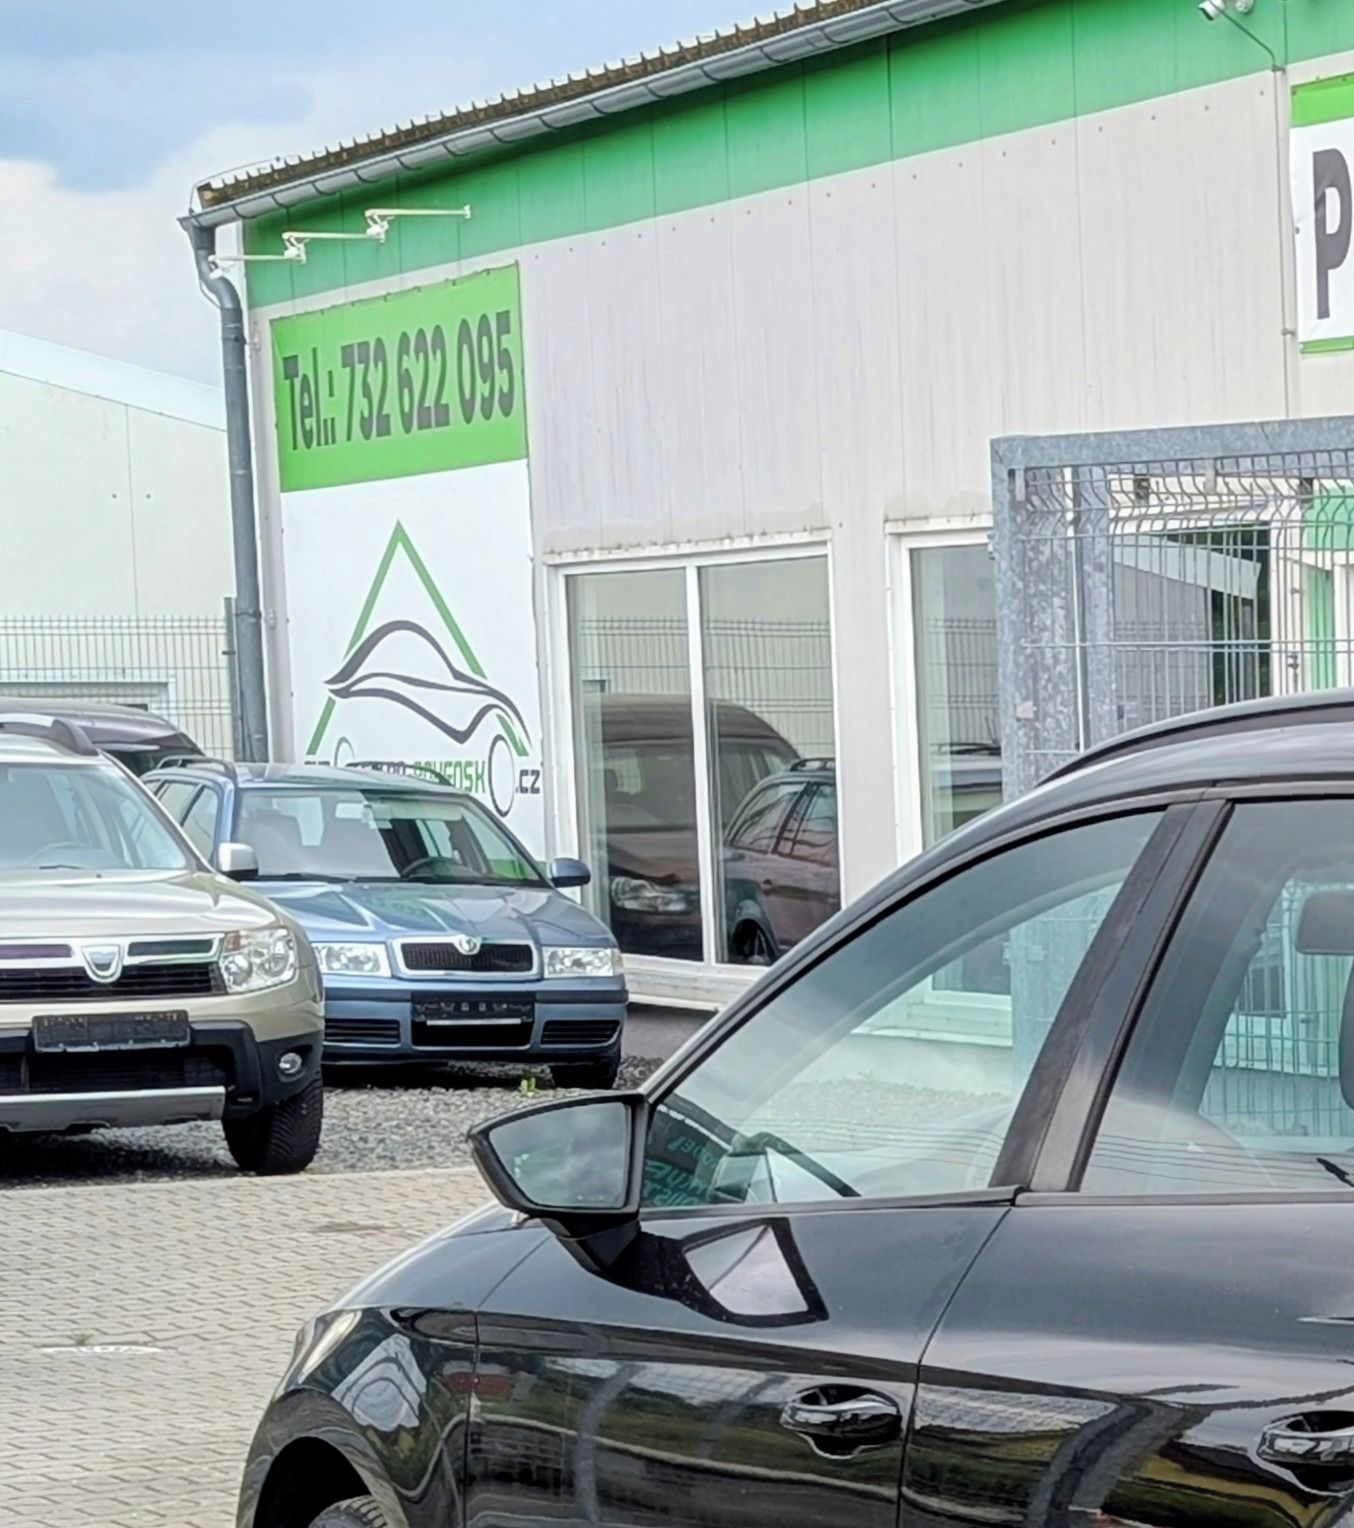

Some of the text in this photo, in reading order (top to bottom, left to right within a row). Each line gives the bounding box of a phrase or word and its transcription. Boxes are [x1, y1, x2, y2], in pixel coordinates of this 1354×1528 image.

[282, 309, 515, 451] Tel.: 732 622 095
